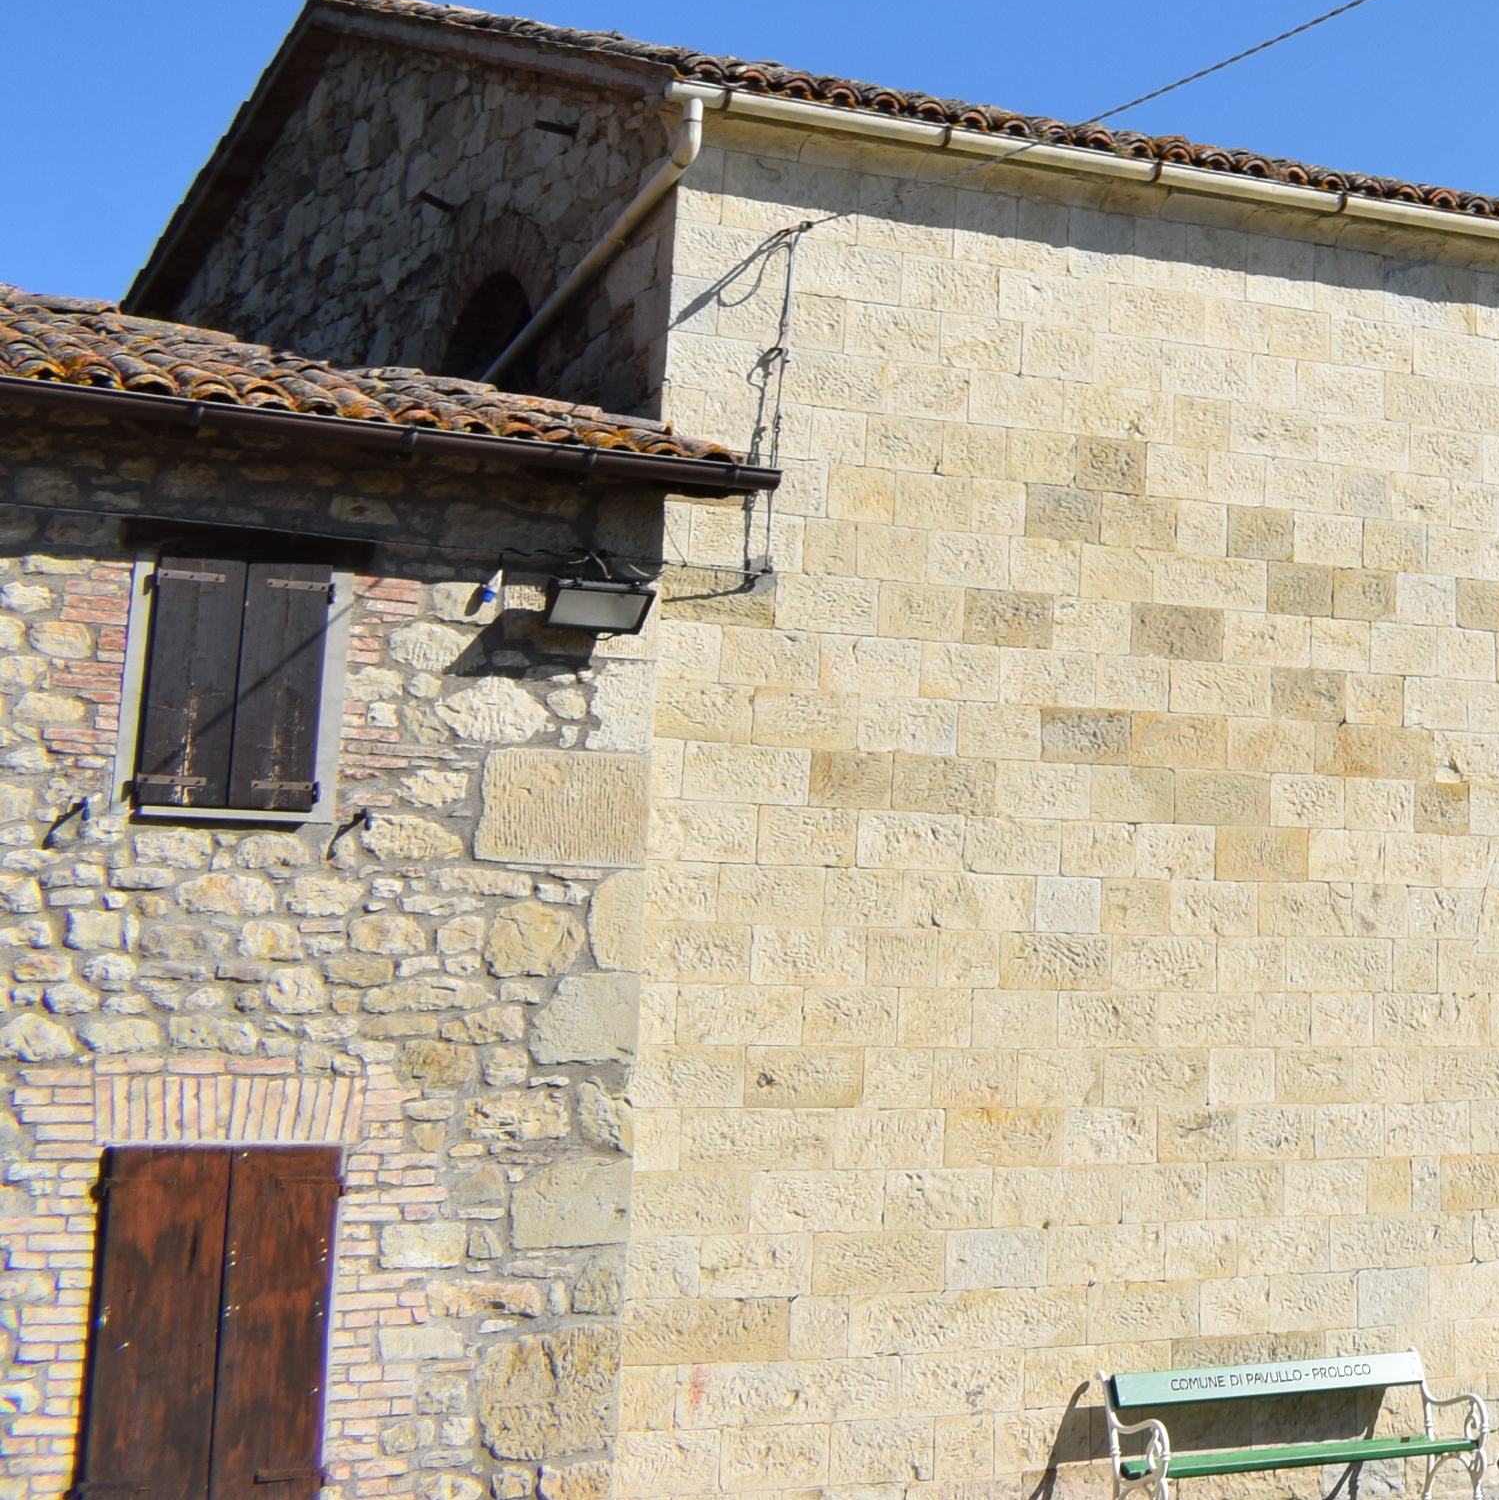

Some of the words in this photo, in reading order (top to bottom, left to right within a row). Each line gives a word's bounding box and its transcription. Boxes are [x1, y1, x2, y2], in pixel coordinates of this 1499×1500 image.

[1170, 1375, 1226, 1391] COMUNE
[1229, 1374, 1243, 1387] DI
[1245, 1369, 1302, 1385] PAVULLO
